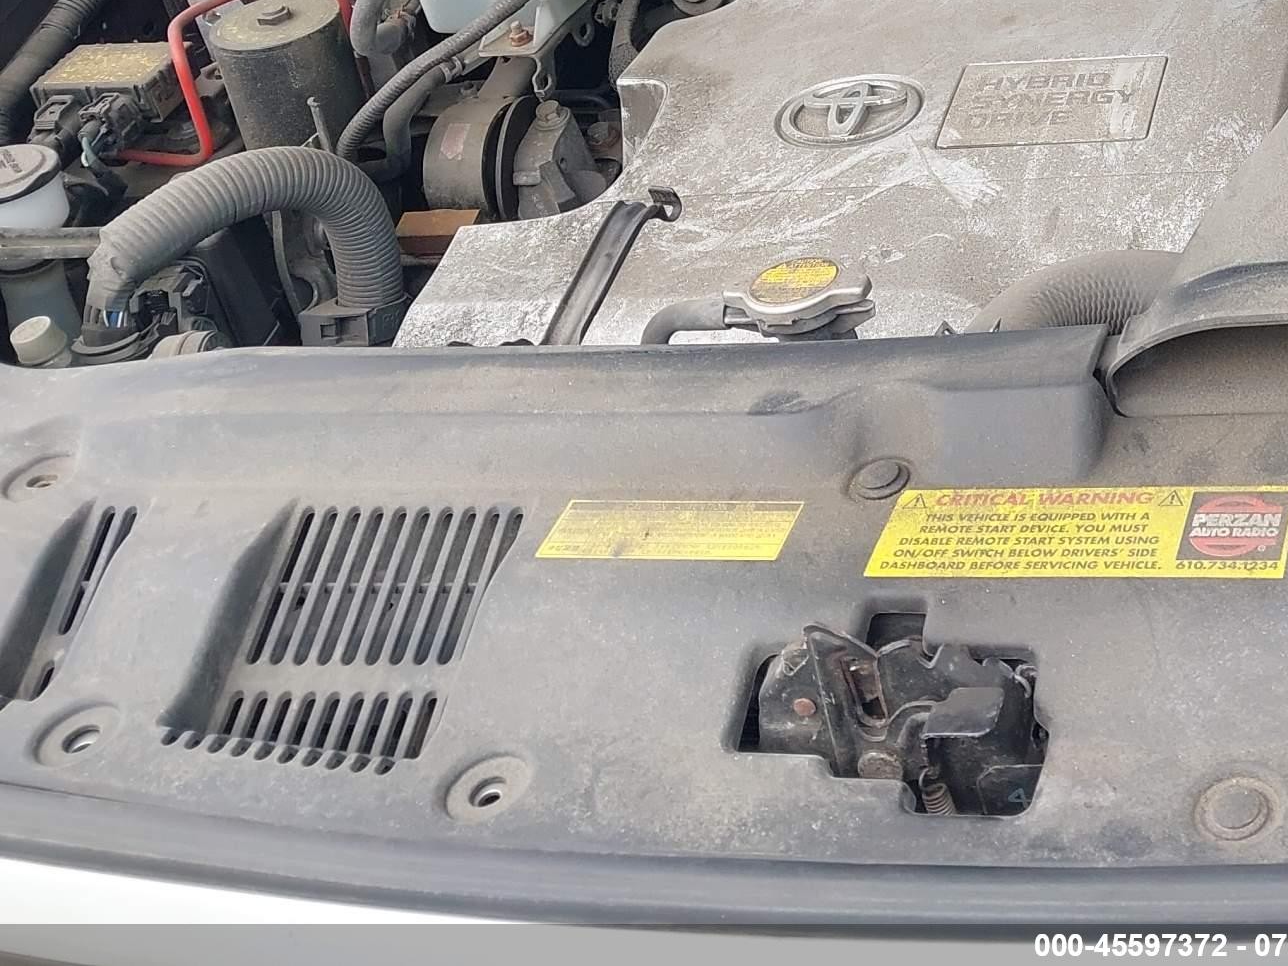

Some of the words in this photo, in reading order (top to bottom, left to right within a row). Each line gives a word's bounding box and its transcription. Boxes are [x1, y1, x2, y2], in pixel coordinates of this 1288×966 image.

[936, 493, 1030, 506] CRITICAL
[1039, 492, 1155, 505] WARNING
[926, 513, 954, 522] THIS
[958, 513, 1010, 522] VEHICLE
[1013, 513, 1027, 522] IS
[1030, 512, 1097, 522] EQUIPPED
[1101, 512, 1136, 521] WITH
[1140, 512, 1150, 520] A
[1191, 513, 1282, 527] PERZAN
[920, 525, 975, 534] REMOTE
[979, 525, 1016, 533] START
[1020, 524, 1069, 533] DEVICE.
[1075, 524, 1106, 533] YOU
[1109, 524, 1149, 532] MUST
[1189, 527, 1230, 538] AUTO
[1232, 527, 1280, 537] RADIO
[899, 537, 954, 546] DISABLE
[955, 537, 1010, 545] REMOTE
[1013, 536, 1055, 545] START
[1058, 536, 1111, 545] SYSTEM
[1114, 536, 1160, 545] USING
[893, 549, 950, 558] ON/OFF
[952, 549, 1005, 558] SWITCH
[1008, 548, 1059, 557] BELOW
[1127, 548, 1158, 557] SIDE
[880, 561, 966, 570] DASHBOARD
[969, 561, 1021, 570] BEFORE
[1023, 561, 1099, 570] SERVICING
[1103, 560, 1163, 570] VEHICLE.
[1175, 561, 1279, 571] 610.734.1234
